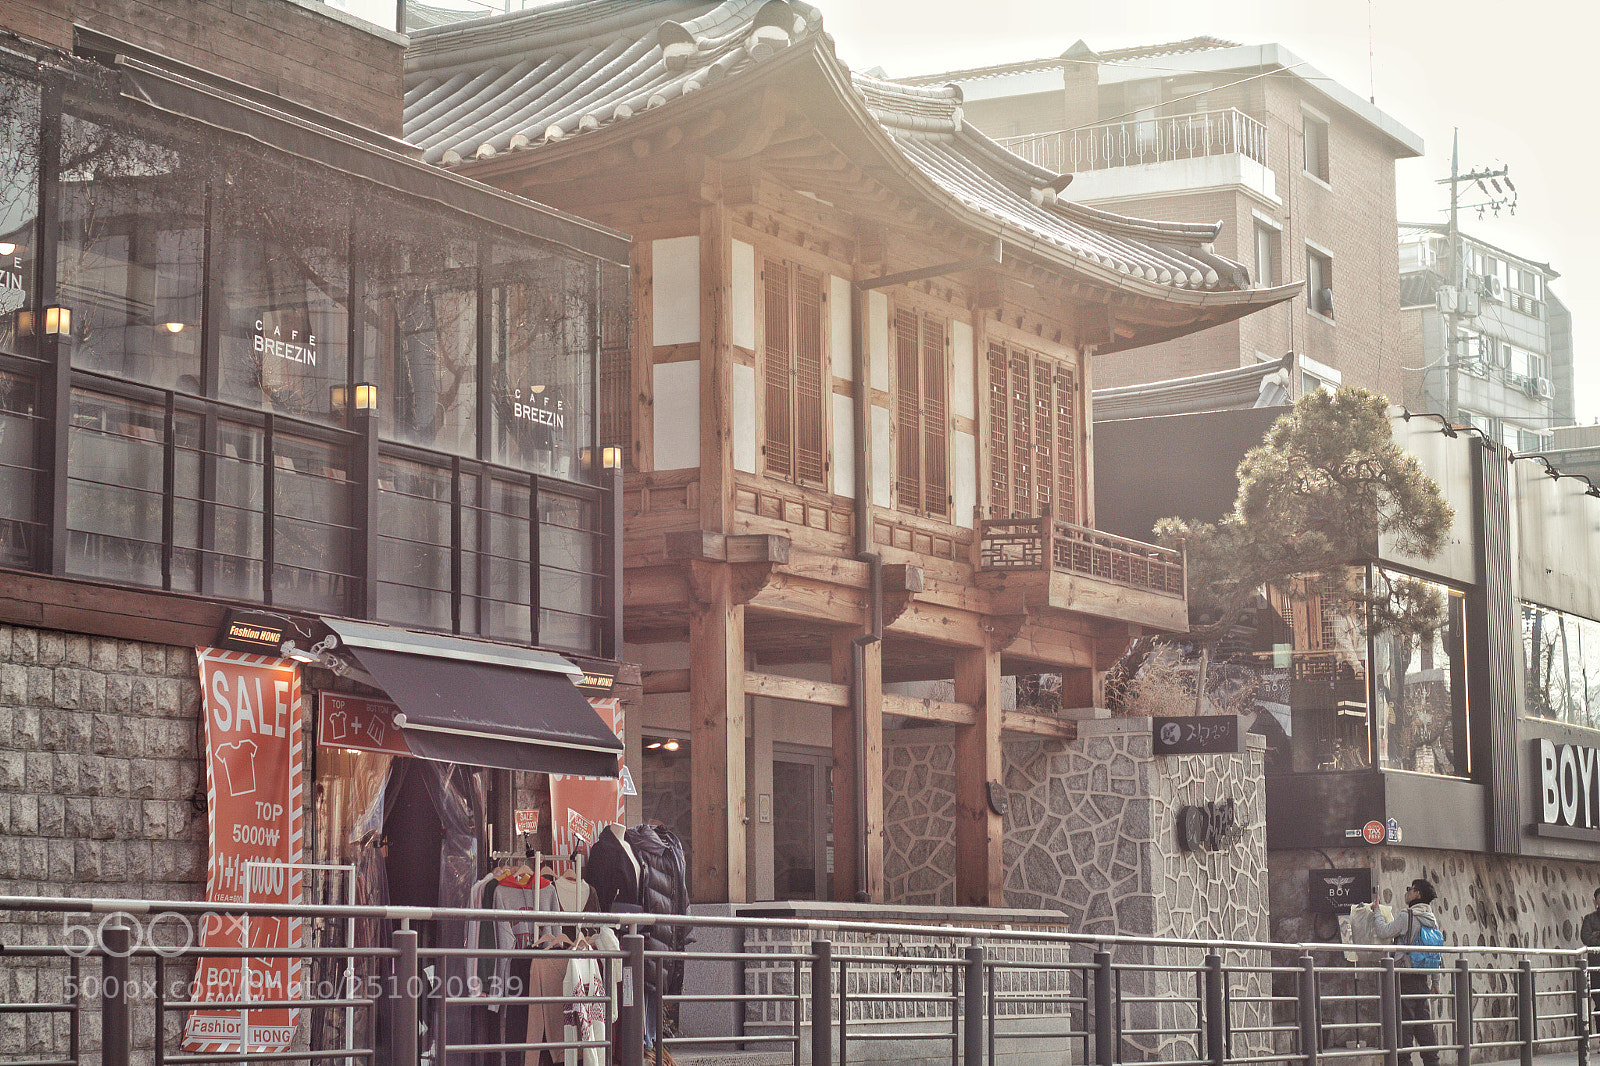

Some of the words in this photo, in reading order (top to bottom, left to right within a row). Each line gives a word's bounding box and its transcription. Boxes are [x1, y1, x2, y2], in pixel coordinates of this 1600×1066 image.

[255, 319, 317, 347] CAFE
[254, 334, 317, 367] BREEZIN
[514, 388, 563, 411] CAFE
[514, 402, 564, 429] BREEZIN
[229, 625, 260, 640] Fashion
[259, 630, 281, 643] HONG
[211, 670, 290, 739] SALE
[331, 699, 346, 710] TOP
[1540, 738, 1600, 829] BOY
[255, 801, 284, 822] TOP
[519, 812, 534, 821] SALE
[1329, 888, 1350, 897] BOY
[206, 967, 282, 989] BOTOM
[253, 1029, 291, 1043] HONG
